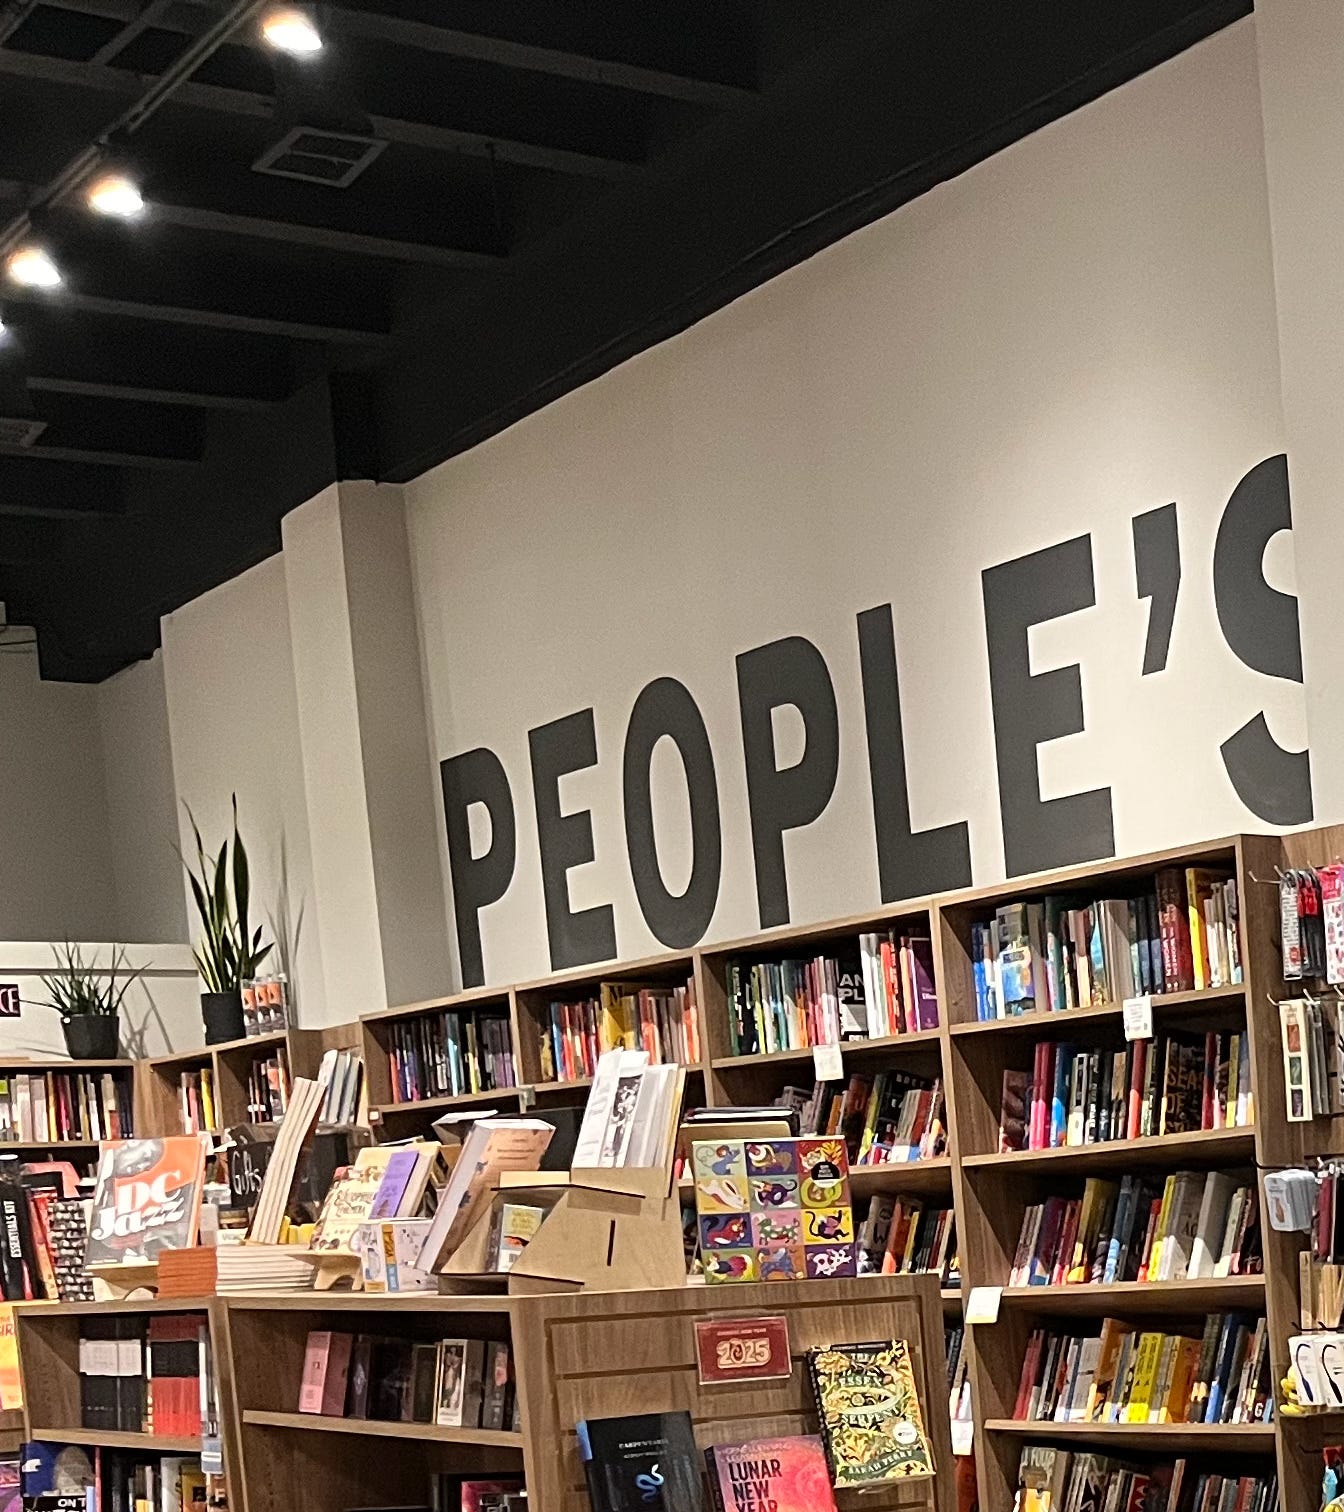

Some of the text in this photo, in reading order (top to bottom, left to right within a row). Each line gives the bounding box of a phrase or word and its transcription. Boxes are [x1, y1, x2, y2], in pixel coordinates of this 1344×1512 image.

[116, 1170, 181, 1210] DC
[92, 1197, 185, 1239] Jazz
[716, 1337, 772, 1368] 2025
[839, 1374, 883, 1389] ESSEX
[840, 1405, 900, 1425] SERPENT
[728, 1459, 782, 1480] LUNAR
[732, 1480, 770, 1501] NEW
[58, 1498, 76, 1508] ON
